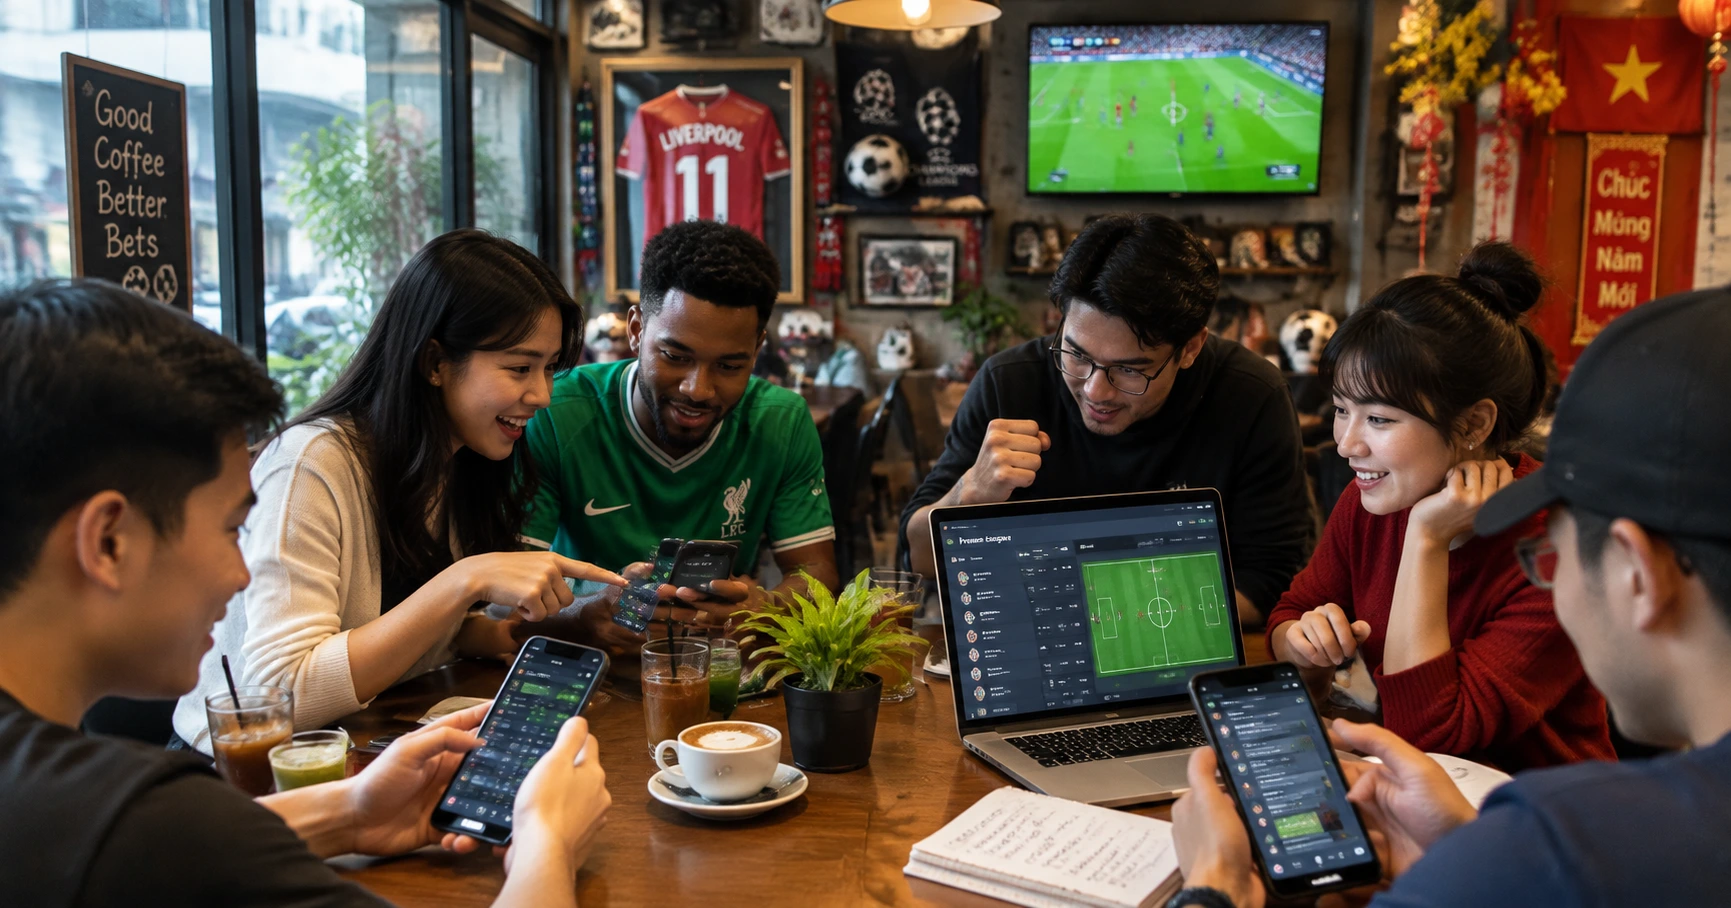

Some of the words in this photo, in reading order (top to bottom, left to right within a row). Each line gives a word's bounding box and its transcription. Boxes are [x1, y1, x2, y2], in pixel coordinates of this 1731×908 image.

[95, 89, 153, 134] Good
[94, 135, 165, 179] Coffee
[659, 122, 745, 152] LIVERPOOL
[96, 179, 167, 219] Better
[675, 154, 729, 224] 11
[104, 222, 159, 258] Bets
